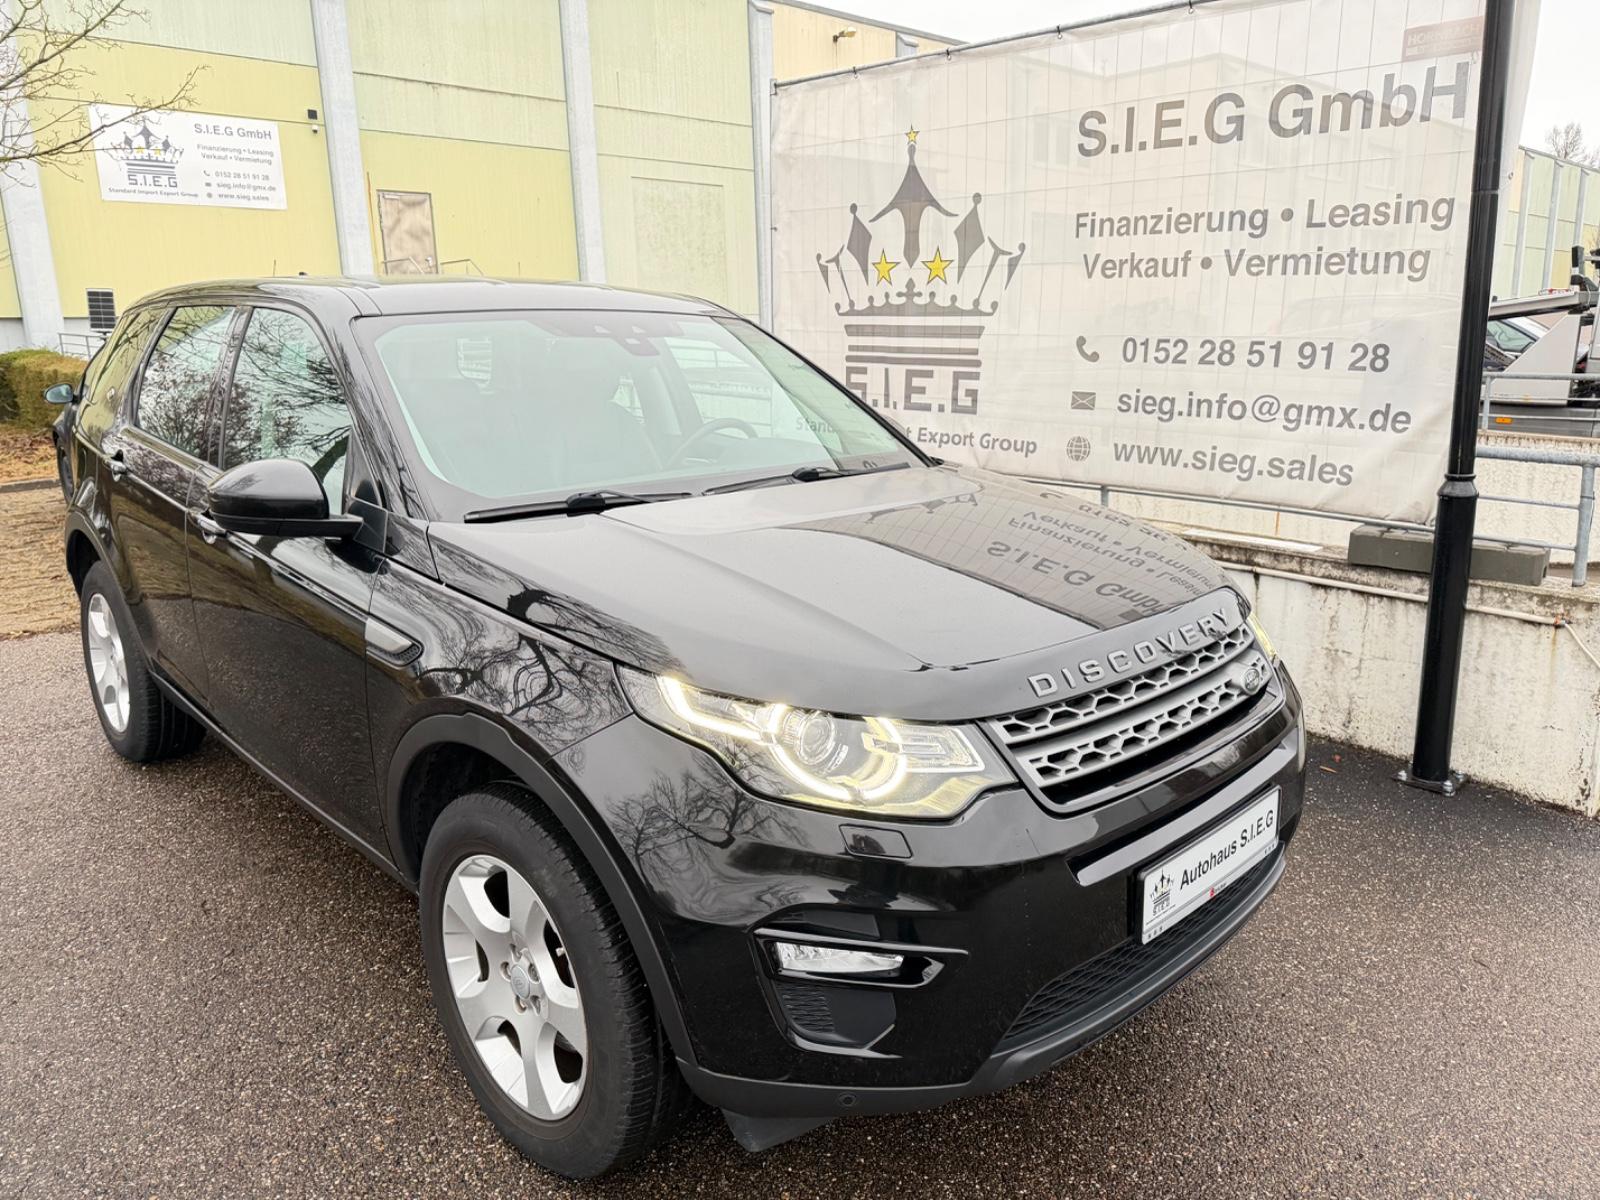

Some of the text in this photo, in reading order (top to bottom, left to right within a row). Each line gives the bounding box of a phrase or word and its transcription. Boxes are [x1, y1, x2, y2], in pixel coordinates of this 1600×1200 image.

[193, 122, 272, 140] S.I.E.G GmbH
[1077, 61, 1471, 159] S.I.E.G GmbH
[127, 174, 178, 188] S.I.E.G
[1075, 193, 1456, 240] Finanzierung Leasing
[1082, 245, 1432, 282] Verkauf Vermietung
[1121, 337, 1391, 373] 0152 28 51 91 28
[845, 366, 981, 415] S.I.E.G
[1116, 388, 1413, 435] sieg.info@gmx.de
[917, 427, 975, 448] Export
[979, 432, 1038, 458] Group
[1113, 442, 1355, 487] www.sieg.sales
[1027, 608, 1229, 698] DISCOVERY
[1180, 809, 1275, 891] Autohaus S.I.E.G
